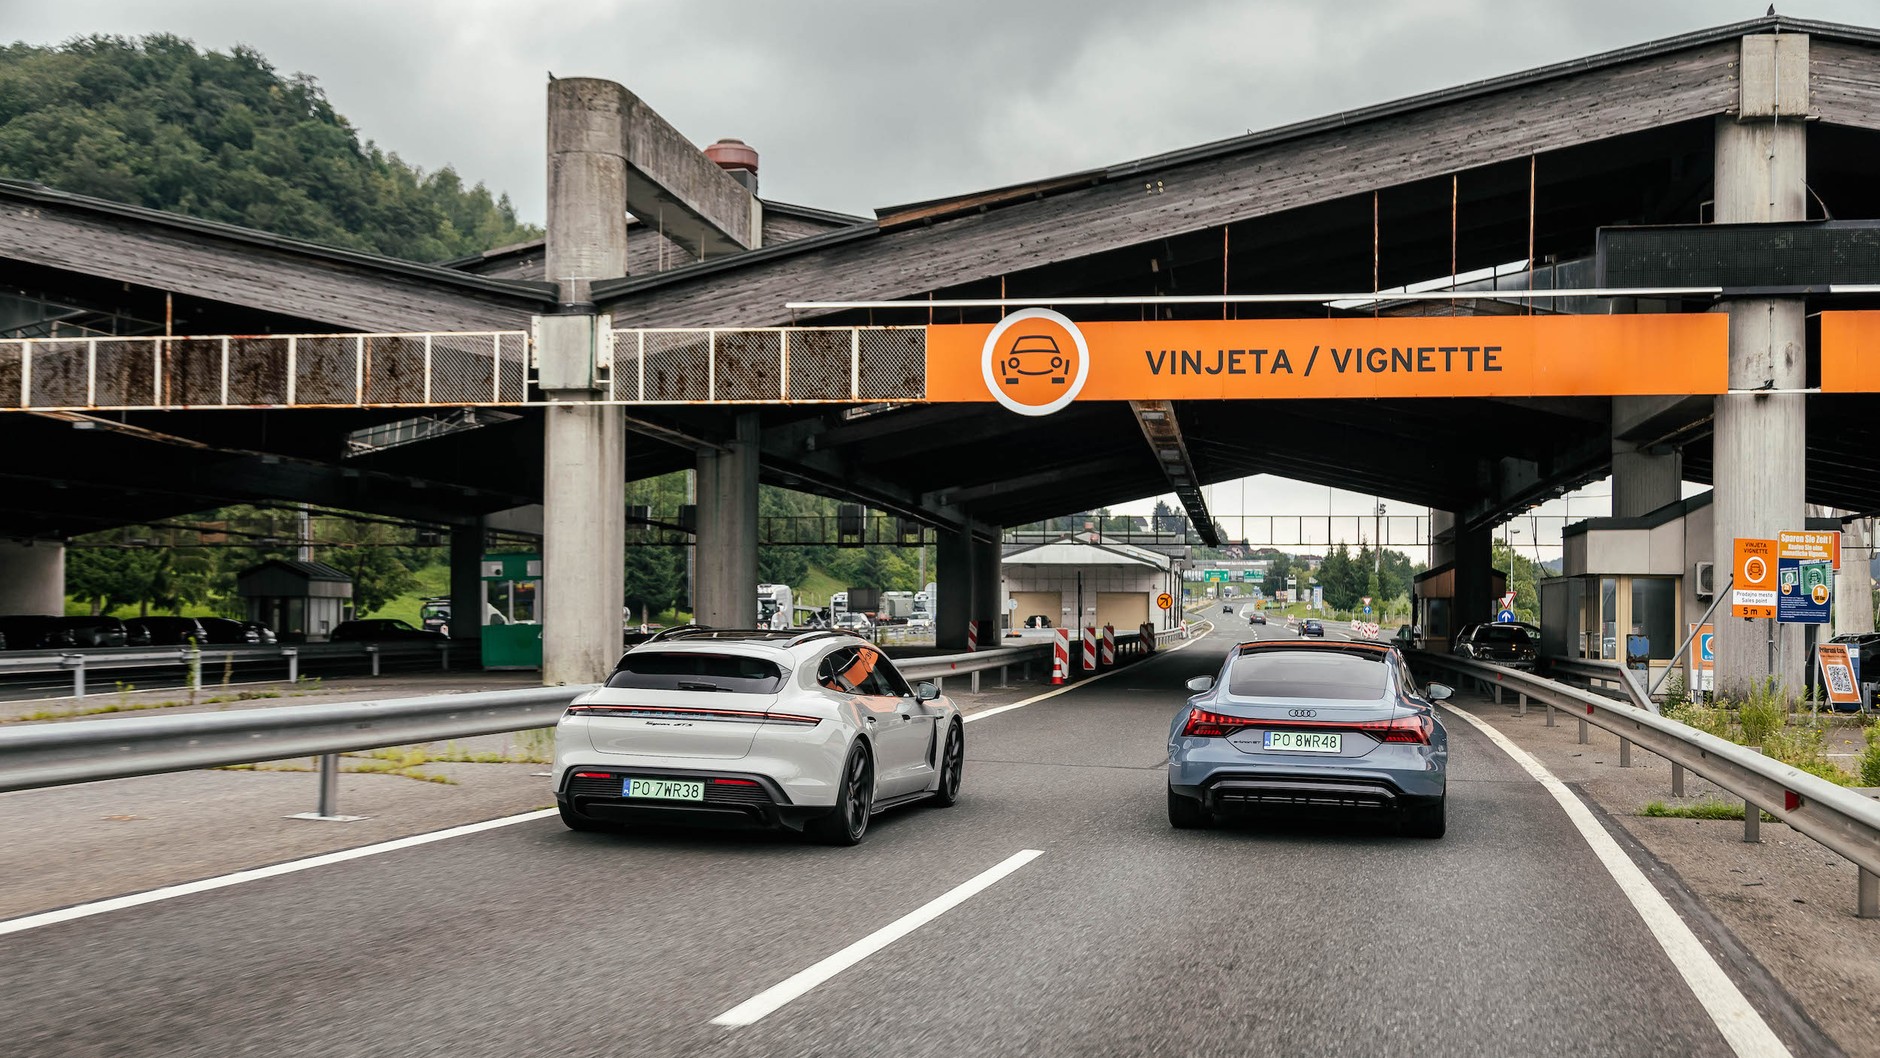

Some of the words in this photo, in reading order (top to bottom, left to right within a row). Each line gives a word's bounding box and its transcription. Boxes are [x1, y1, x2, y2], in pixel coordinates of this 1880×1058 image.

[1145, 348, 1293, 376] VINJETA
[1303, 345, 1320, 377] /
[1330, 346, 1502, 374] VIGNETTE
[1781, 533, 1804, 543] Sparen
[1805, 535, 1816, 543] Sie
[1816, 536, 1828, 544] Zeit
[1743, 607, 1749, 615] 5
[1273, 733, 1291, 747] PO
[1295, 734, 1337, 749] 8WR48
[632, 781, 650, 796] PO
[655, 782, 699, 799] 7WR38
